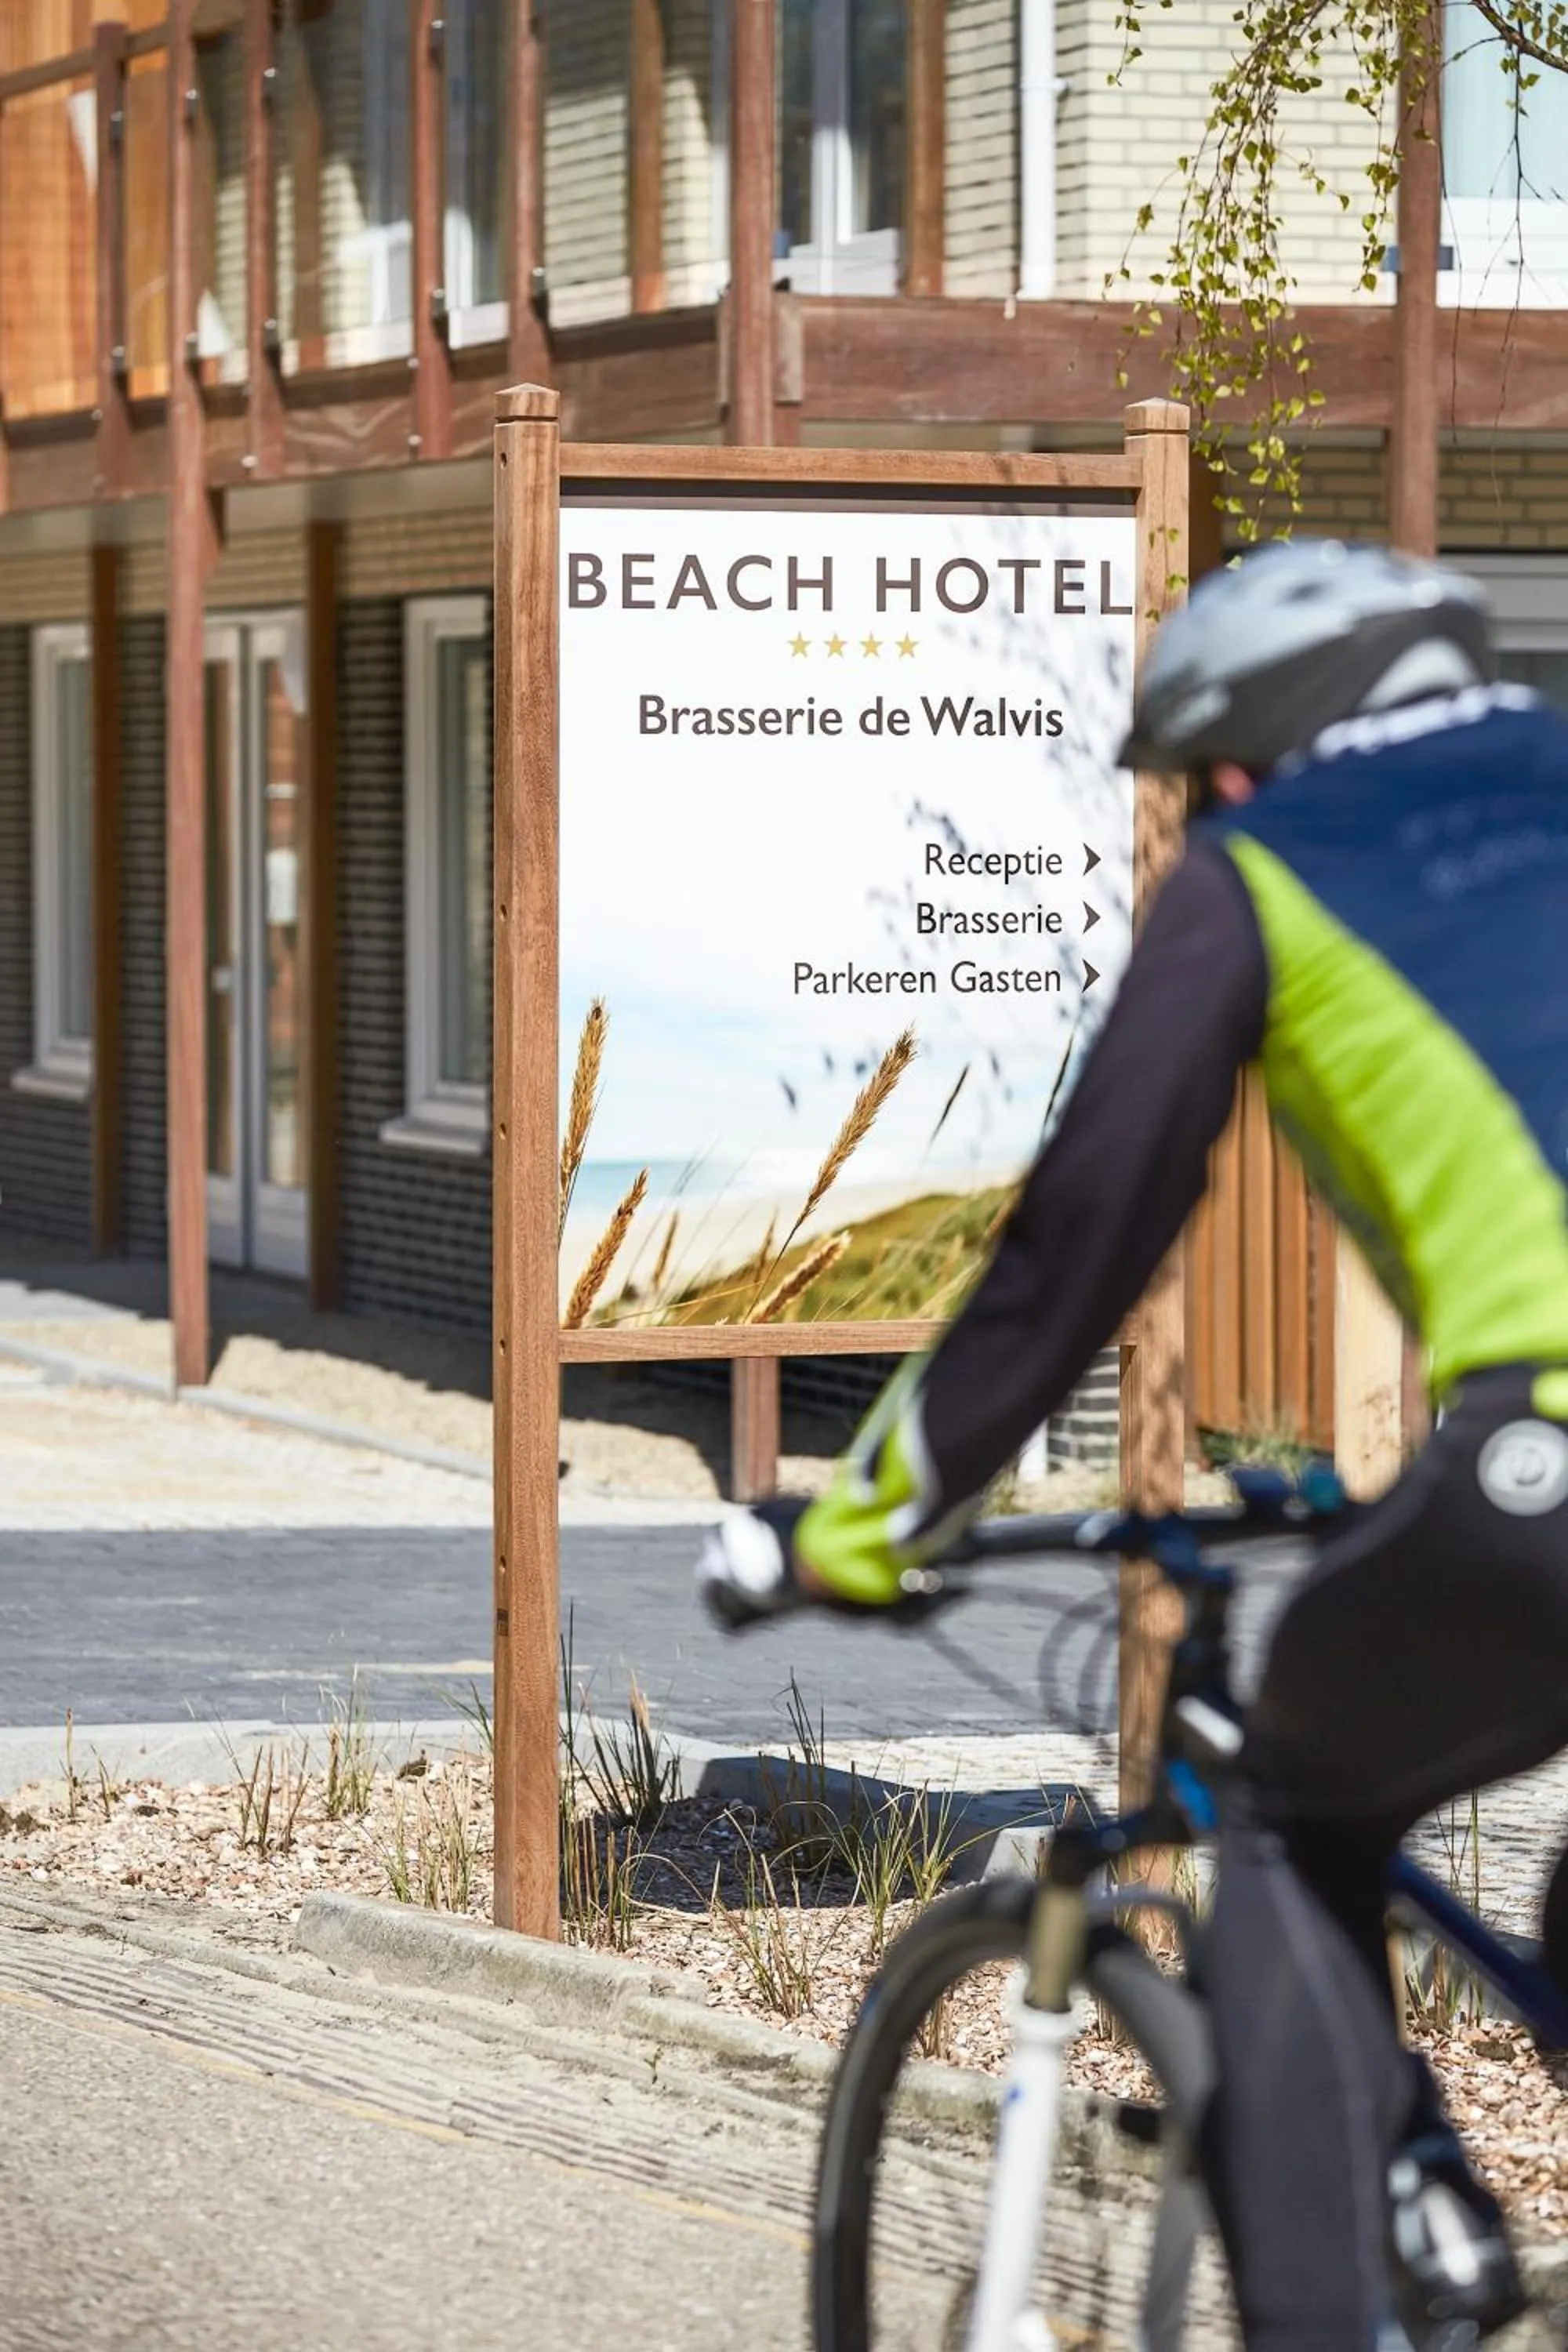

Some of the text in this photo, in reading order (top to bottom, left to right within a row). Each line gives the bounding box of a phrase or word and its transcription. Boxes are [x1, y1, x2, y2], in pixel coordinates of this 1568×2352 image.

[568, 552, 1134, 615] BEACH HOTEL
[639, 695, 1064, 738] Brasserie de Walvis
[924, 843, 1063, 884] Receptie
[916, 902, 1063, 935] Brasserie
[793, 960, 1062, 994] Parkeren Gasten
